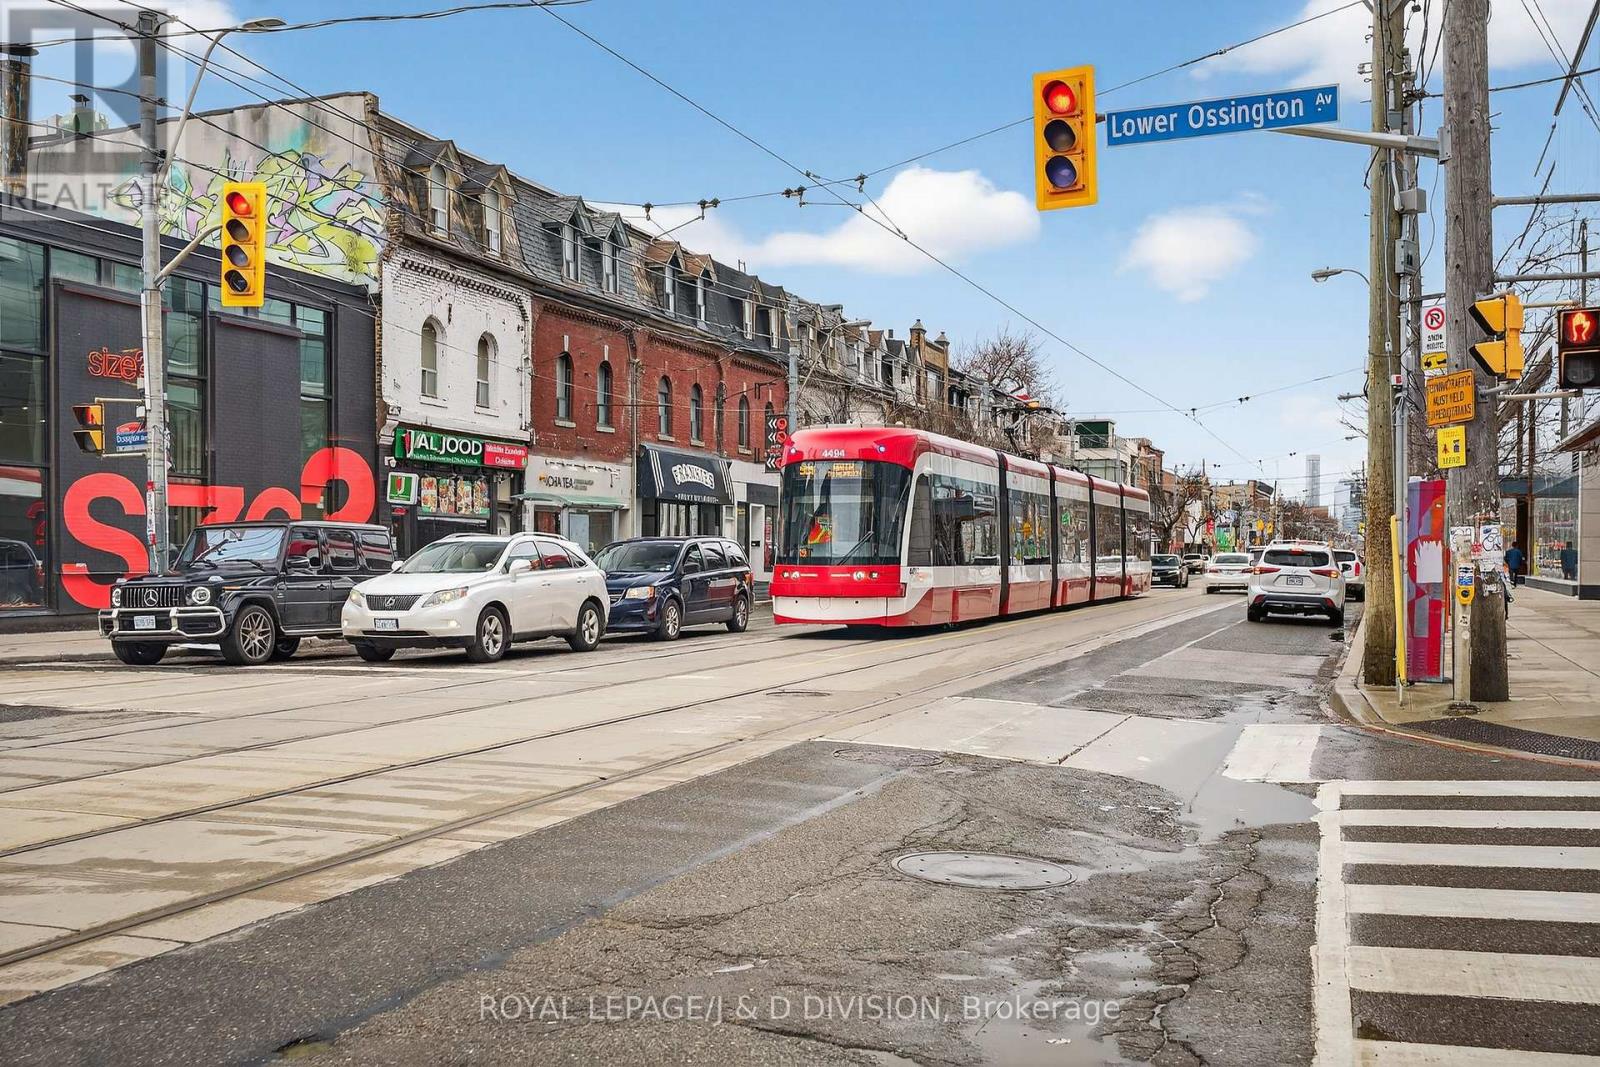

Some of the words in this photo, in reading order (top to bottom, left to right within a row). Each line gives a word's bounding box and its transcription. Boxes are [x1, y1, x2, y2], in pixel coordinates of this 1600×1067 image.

[1111, 112, 1177, 138] Lower
[1188, 97, 1304, 129] Ossington
[1315, 93, 1332, 106] Av
[438, 436, 482, 456] JOOD
